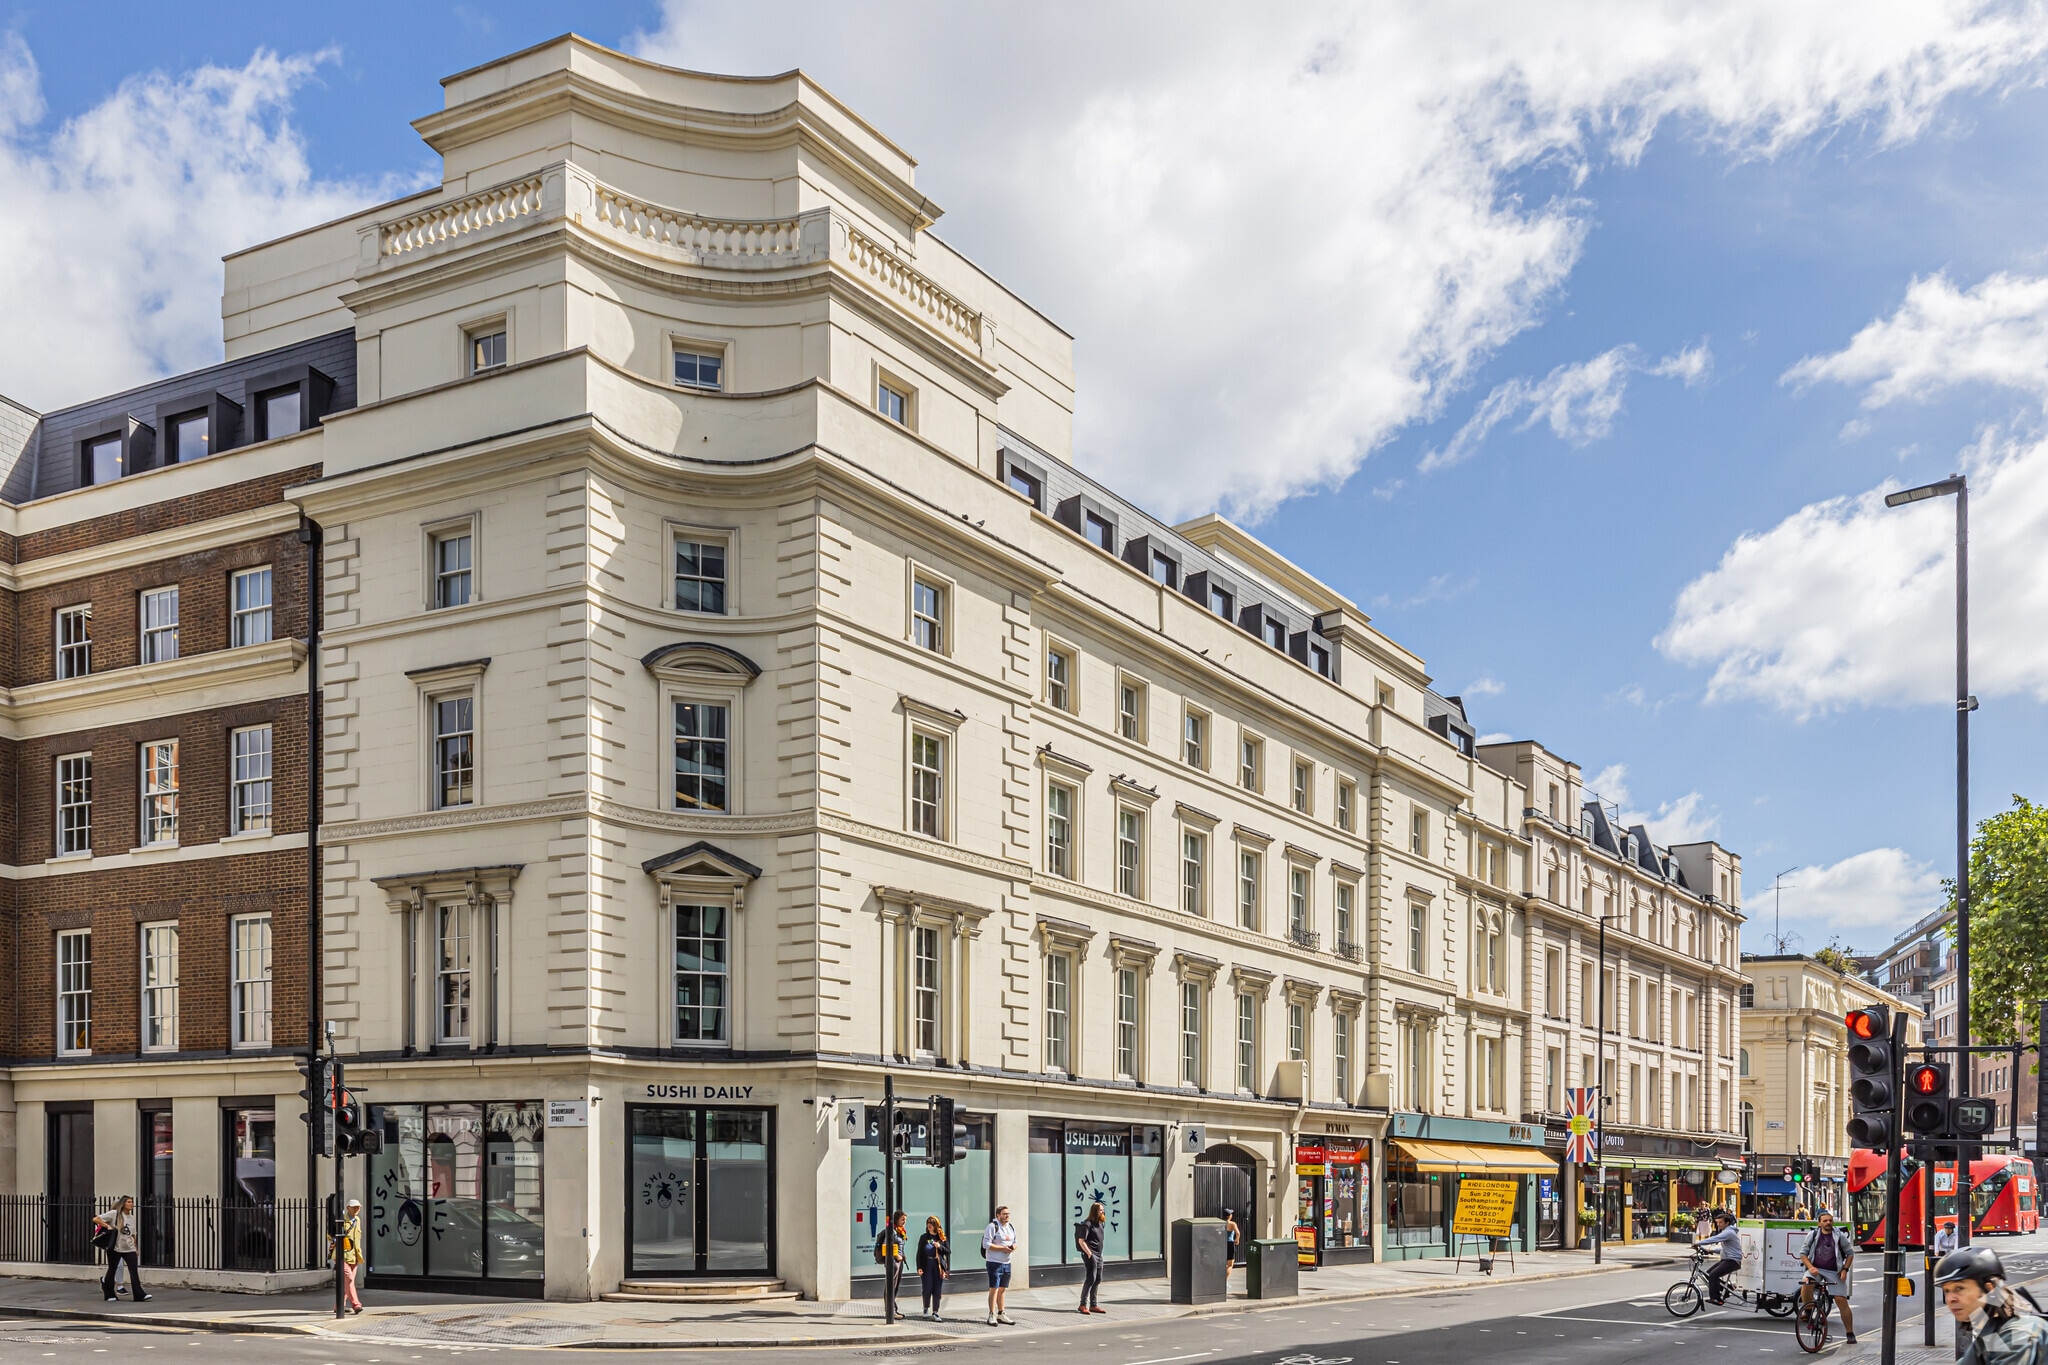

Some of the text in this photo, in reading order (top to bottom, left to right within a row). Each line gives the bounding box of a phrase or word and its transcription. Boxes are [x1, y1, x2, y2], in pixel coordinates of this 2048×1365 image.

[647, 1085, 753, 1099] SUSHI DAILY
[404, 1118, 452, 1133] SUHI
[1325, 1122, 1350, 1133] RYMAN
[1065, 1132, 1122, 1147] USHI DAILY
[1328, 1143, 1356, 1154] Ryman
[643, 1172, 687, 1206] SUSHI DAILY
[373, 1163, 404, 1238] SUSHI
[1075, 1170, 1120, 1233] USHI DAILY
[1478, 1204, 1505, 1212] Kingsway
